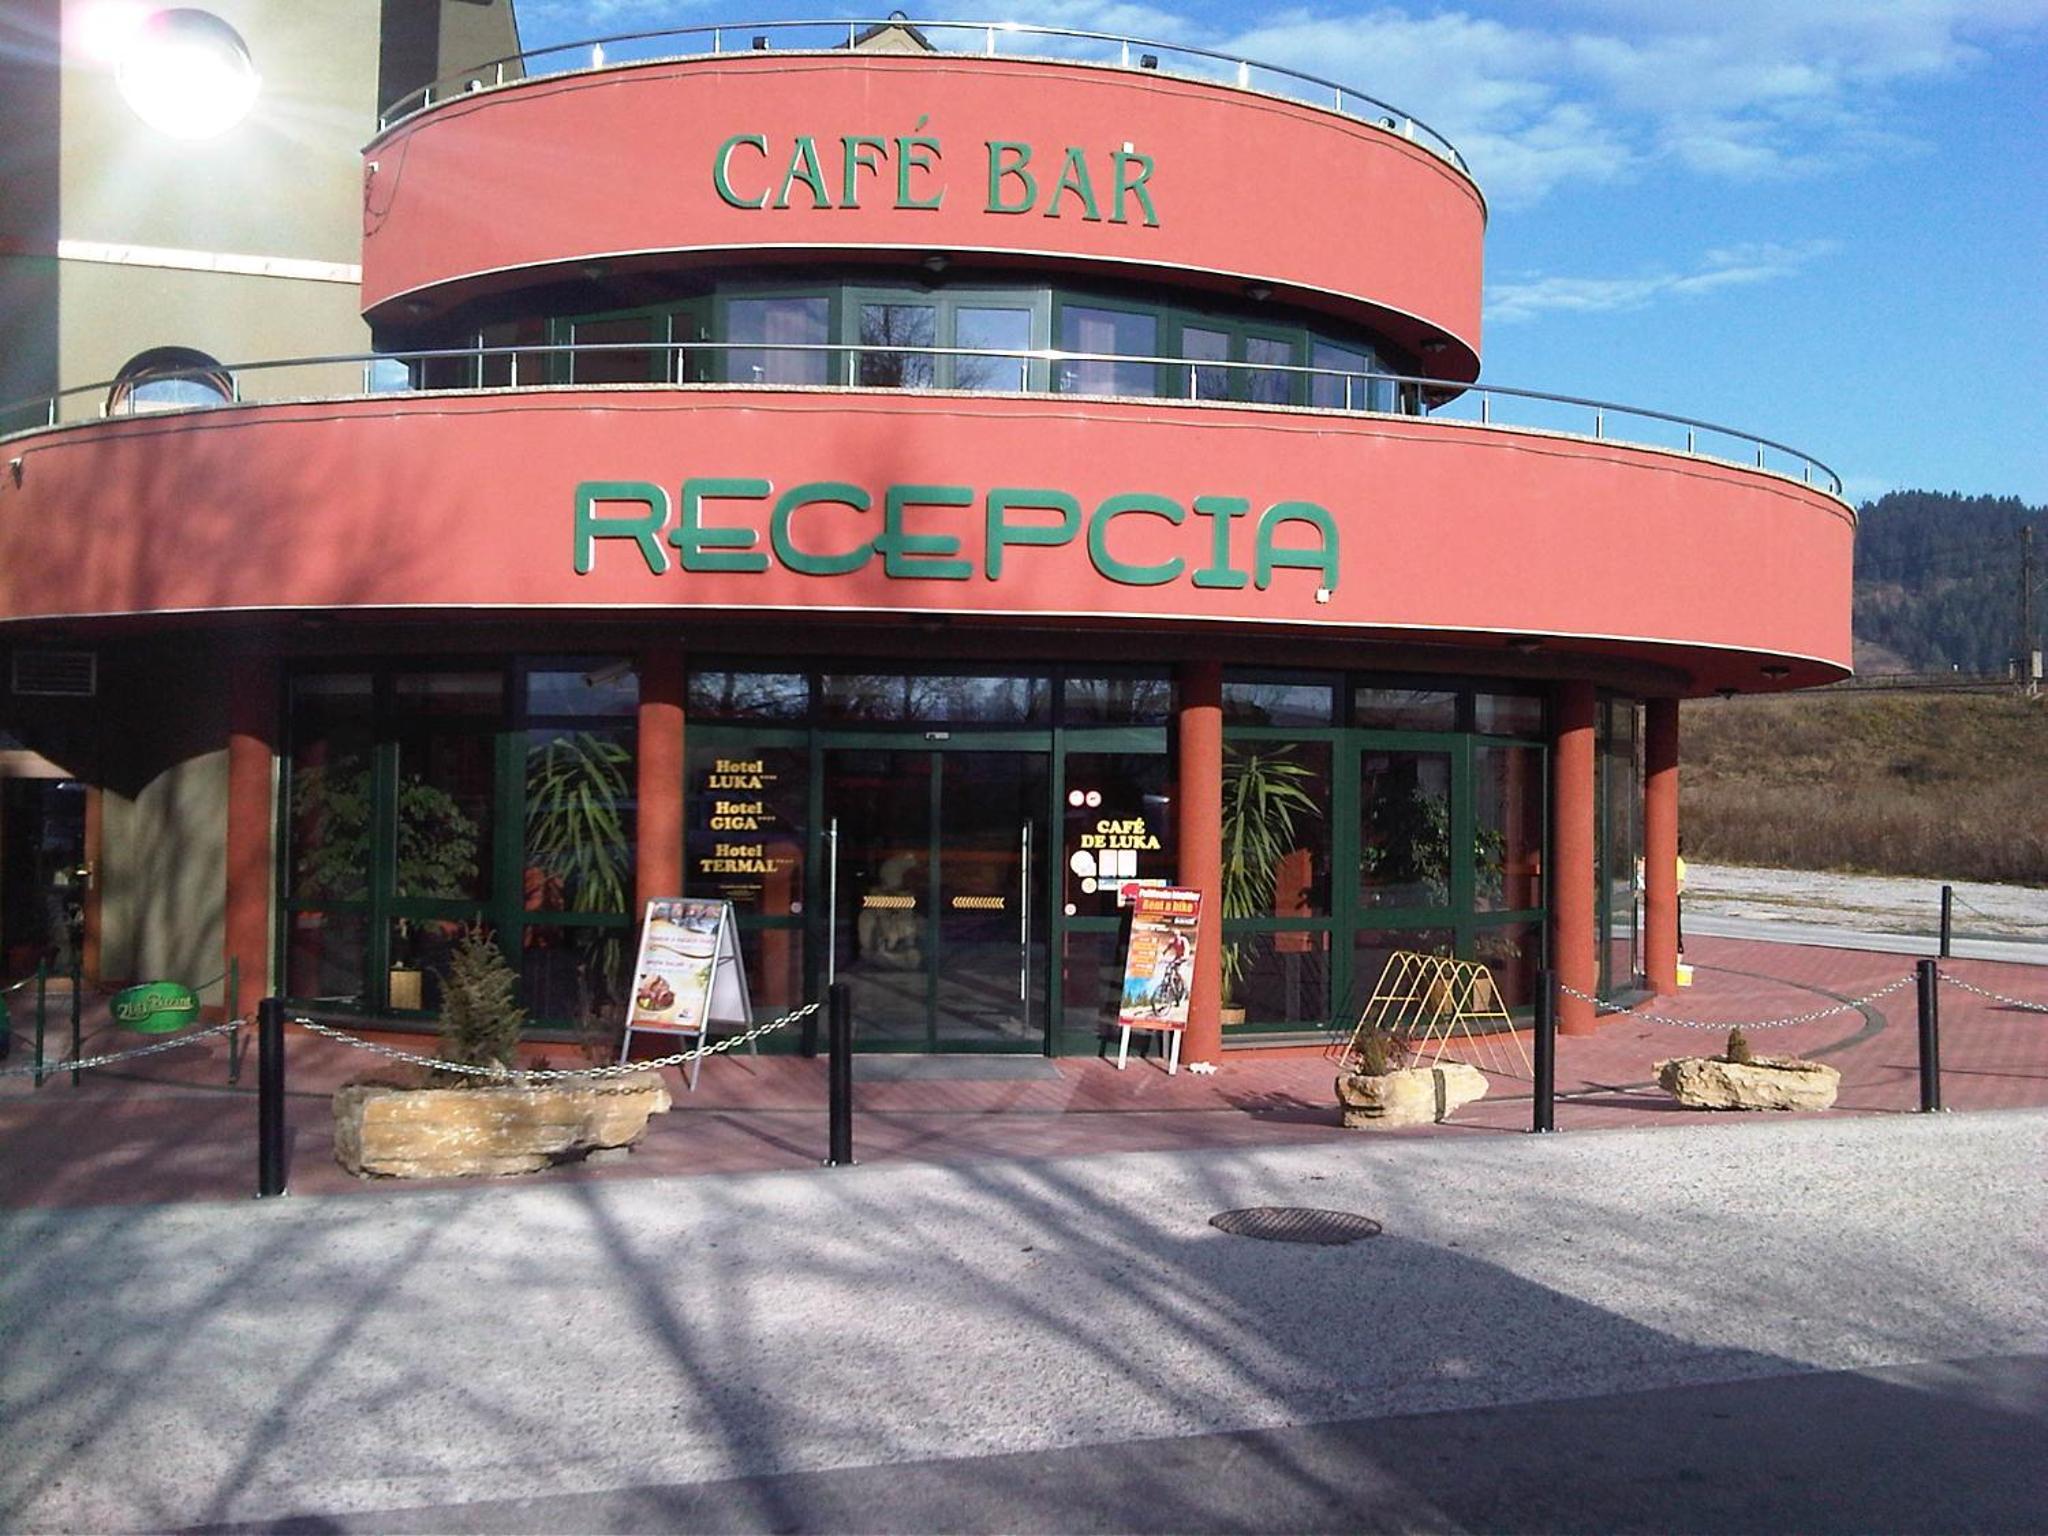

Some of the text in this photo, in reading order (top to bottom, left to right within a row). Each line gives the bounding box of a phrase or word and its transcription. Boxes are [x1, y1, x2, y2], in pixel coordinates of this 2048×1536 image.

[713, 113, 1160, 228] CAFÉ BAR
[574, 479, 1340, 592] RECEPCIA
[715, 760, 764, 773] Hotel
[708, 775, 763, 790] LUKA
[715, 801, 763, 814] Hotel
[709, 816, 759, 830] GIGA
[1096, 817, 1146, 835] CAFÉ
[1080, 834, 1161, 850] DE LUKA
[715, 844, 763, 857] Hotel
[699, 859, 778, 873] TERMAL
